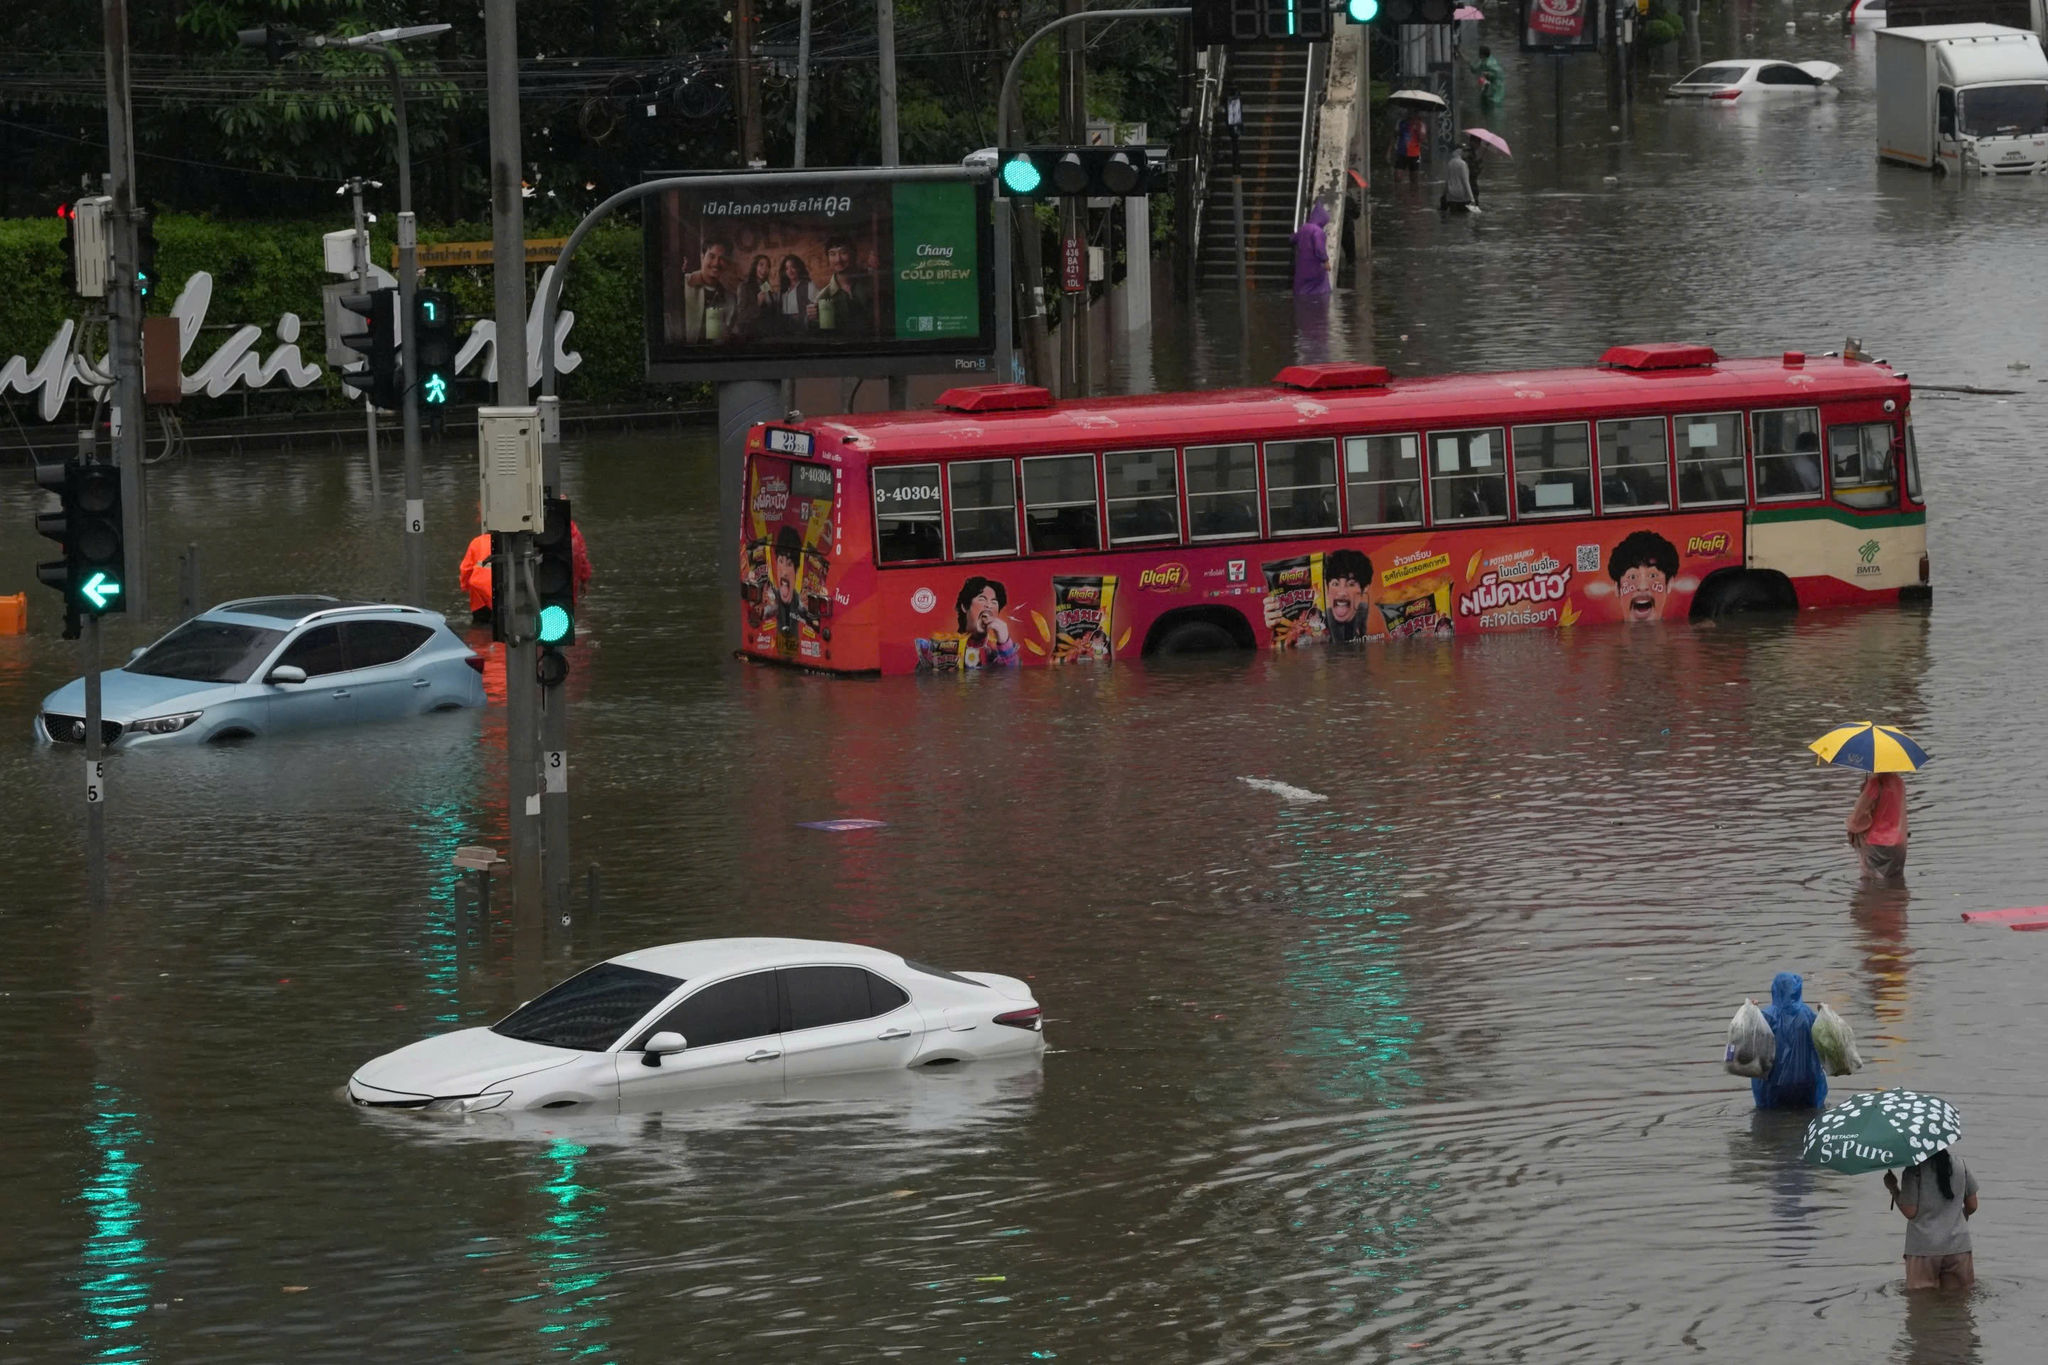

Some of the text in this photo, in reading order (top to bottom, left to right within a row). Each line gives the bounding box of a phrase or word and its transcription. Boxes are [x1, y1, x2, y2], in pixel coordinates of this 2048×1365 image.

[1539, 14, 1576, 26] SINGHA
[1067, 239, 1077, 248] SV
[916, 244, 954, 258] Chang
[1067, 256, 1078, 265] BA
[900, 269, 971, 280] COLD BREW
[800, 466, 832, 485] 3-40304
[876, 485, 941, 503] 3-40304
[412, 519, 421, 532] 6
[1856, 565, 1880, 574] BMTA
[550, 752, 561, 768] 3
[96, 762, 104, 778] 5
[88, 785, 98, 802] 5
